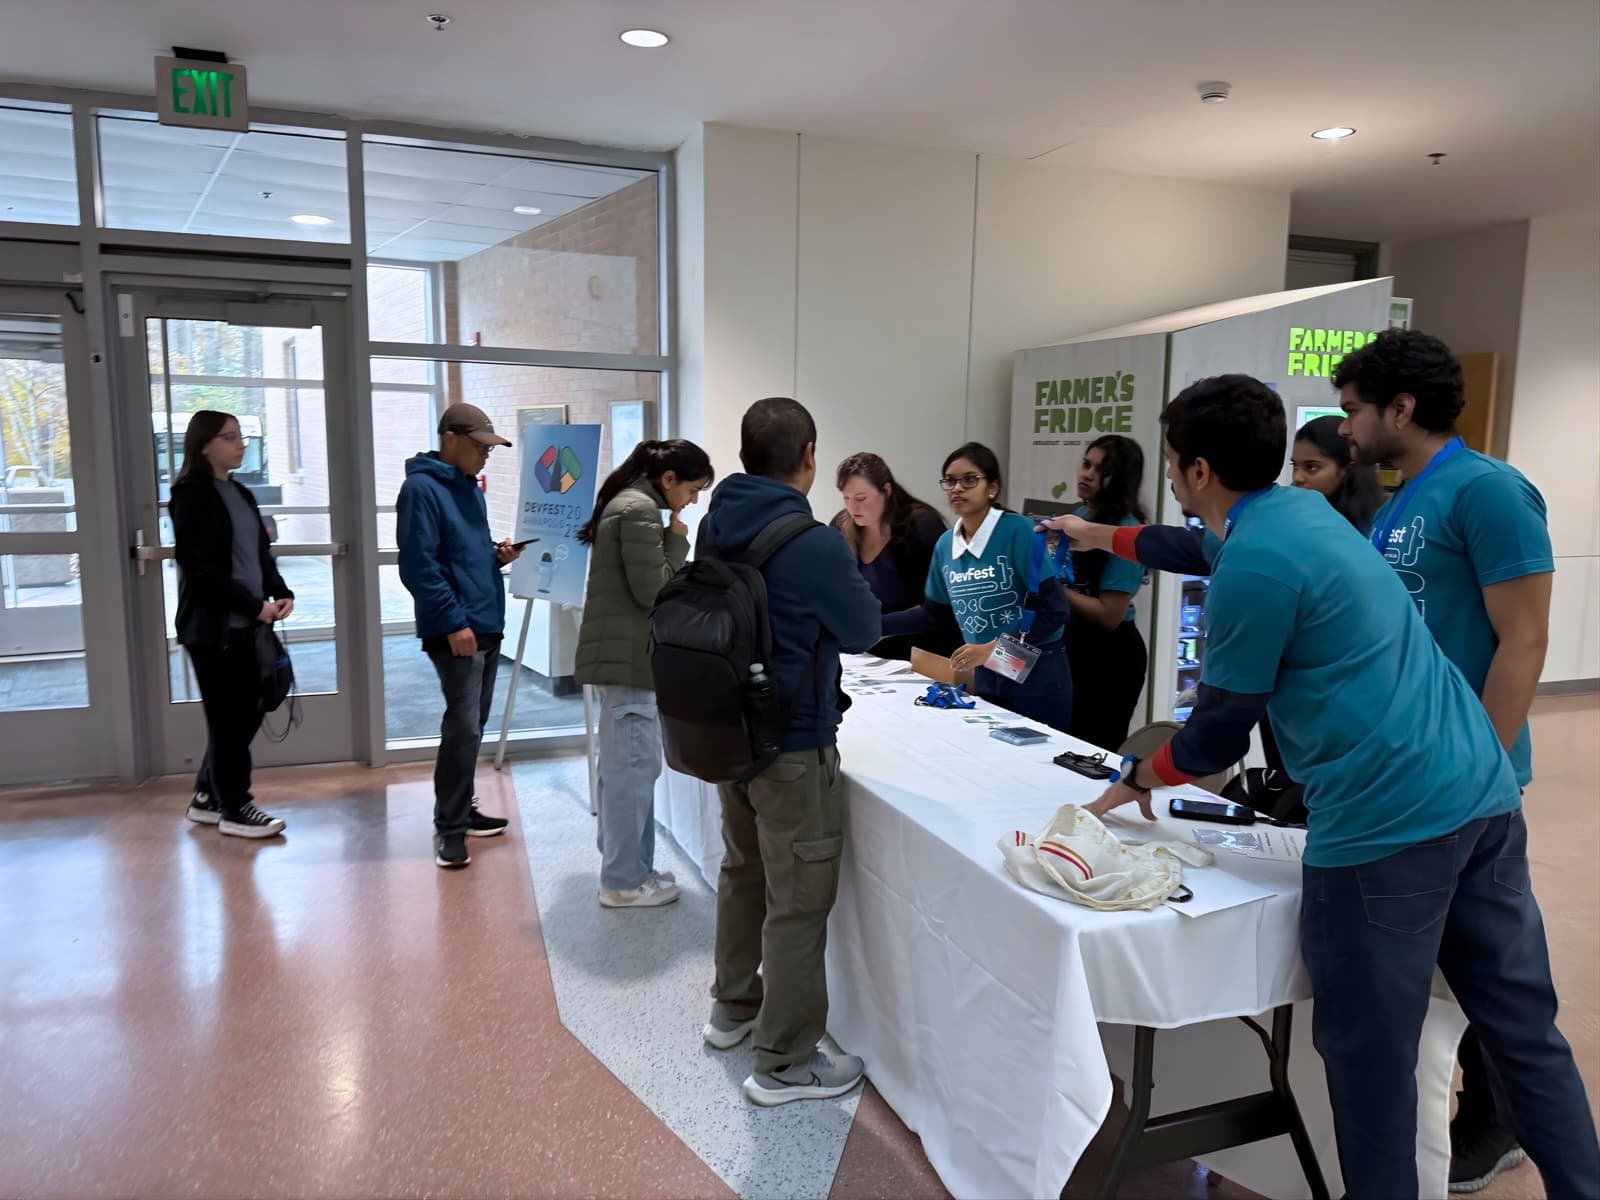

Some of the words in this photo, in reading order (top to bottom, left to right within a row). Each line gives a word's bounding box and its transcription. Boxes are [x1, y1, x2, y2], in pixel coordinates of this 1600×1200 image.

[172, 67, 234, 118] EXIT
[1035, 370, 1135, 406] FARMER'S
[1033, 405, 1134, 433] FRIDGE
[524, 502, 565, 515] DEVFEST
[566, 504, 582, 520] 20
[949, 565, 996, 583] DevFest
